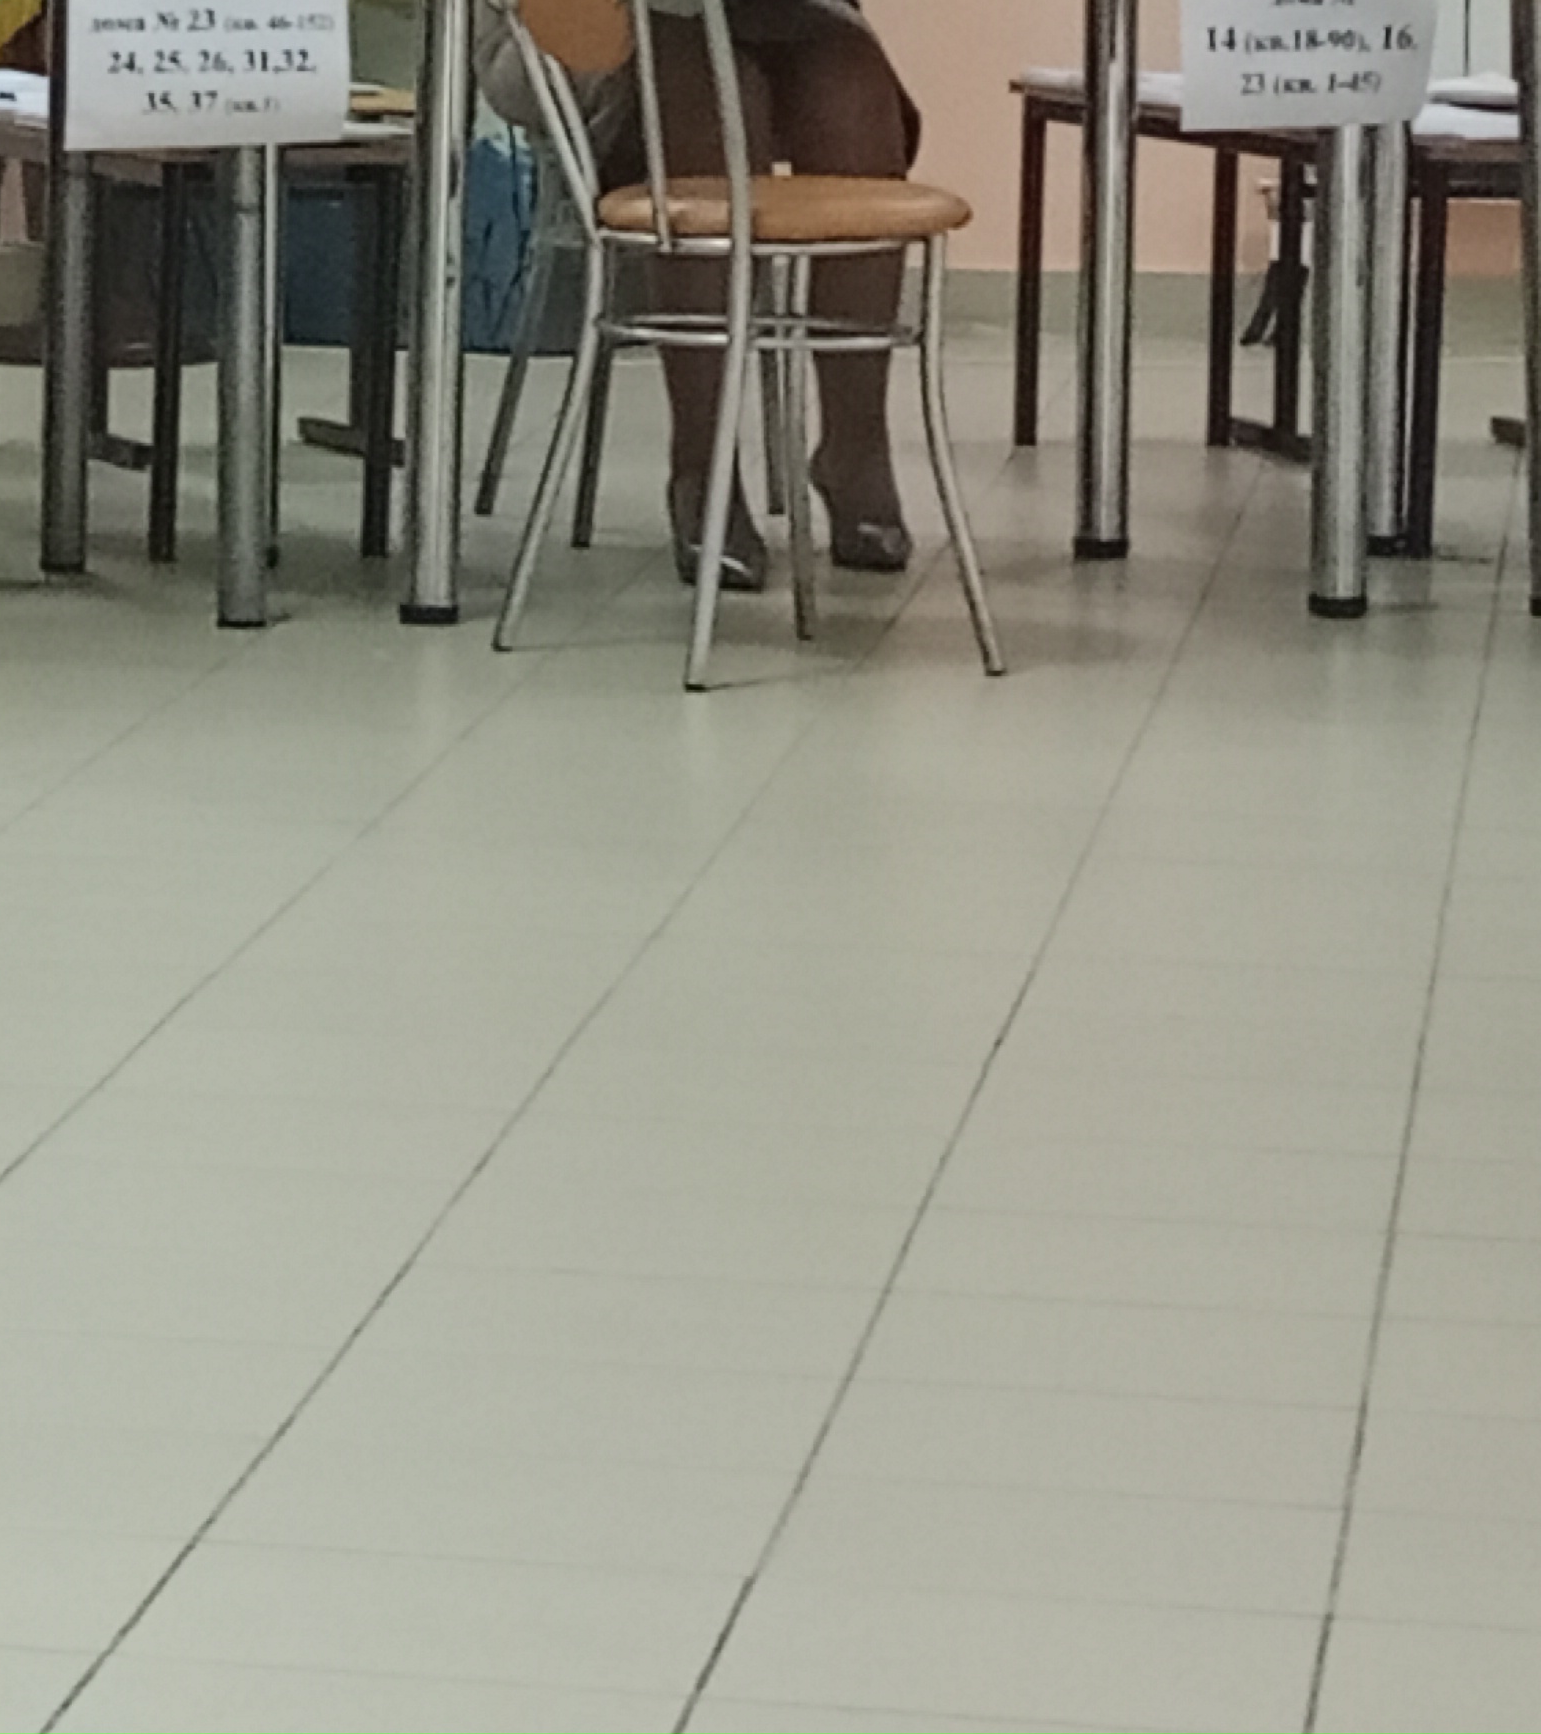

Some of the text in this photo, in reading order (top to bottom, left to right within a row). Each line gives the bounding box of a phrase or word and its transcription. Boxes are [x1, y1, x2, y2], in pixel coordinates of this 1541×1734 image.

[90, 16, 146, 33] дома
[153, 11, 180, 32] №
[186, 8, 216, 32] 23
[1207, 26, 1236, 52] 14
[1382, 23, 1418, 52] 16,
[107, 50, 144, 75] 24,
[154, 49, 190, 74] 25,
[198, 49, 234, 74] 26,
[1240, 72, 1265, 96] 23
[188, 90, 218, 115] 37
